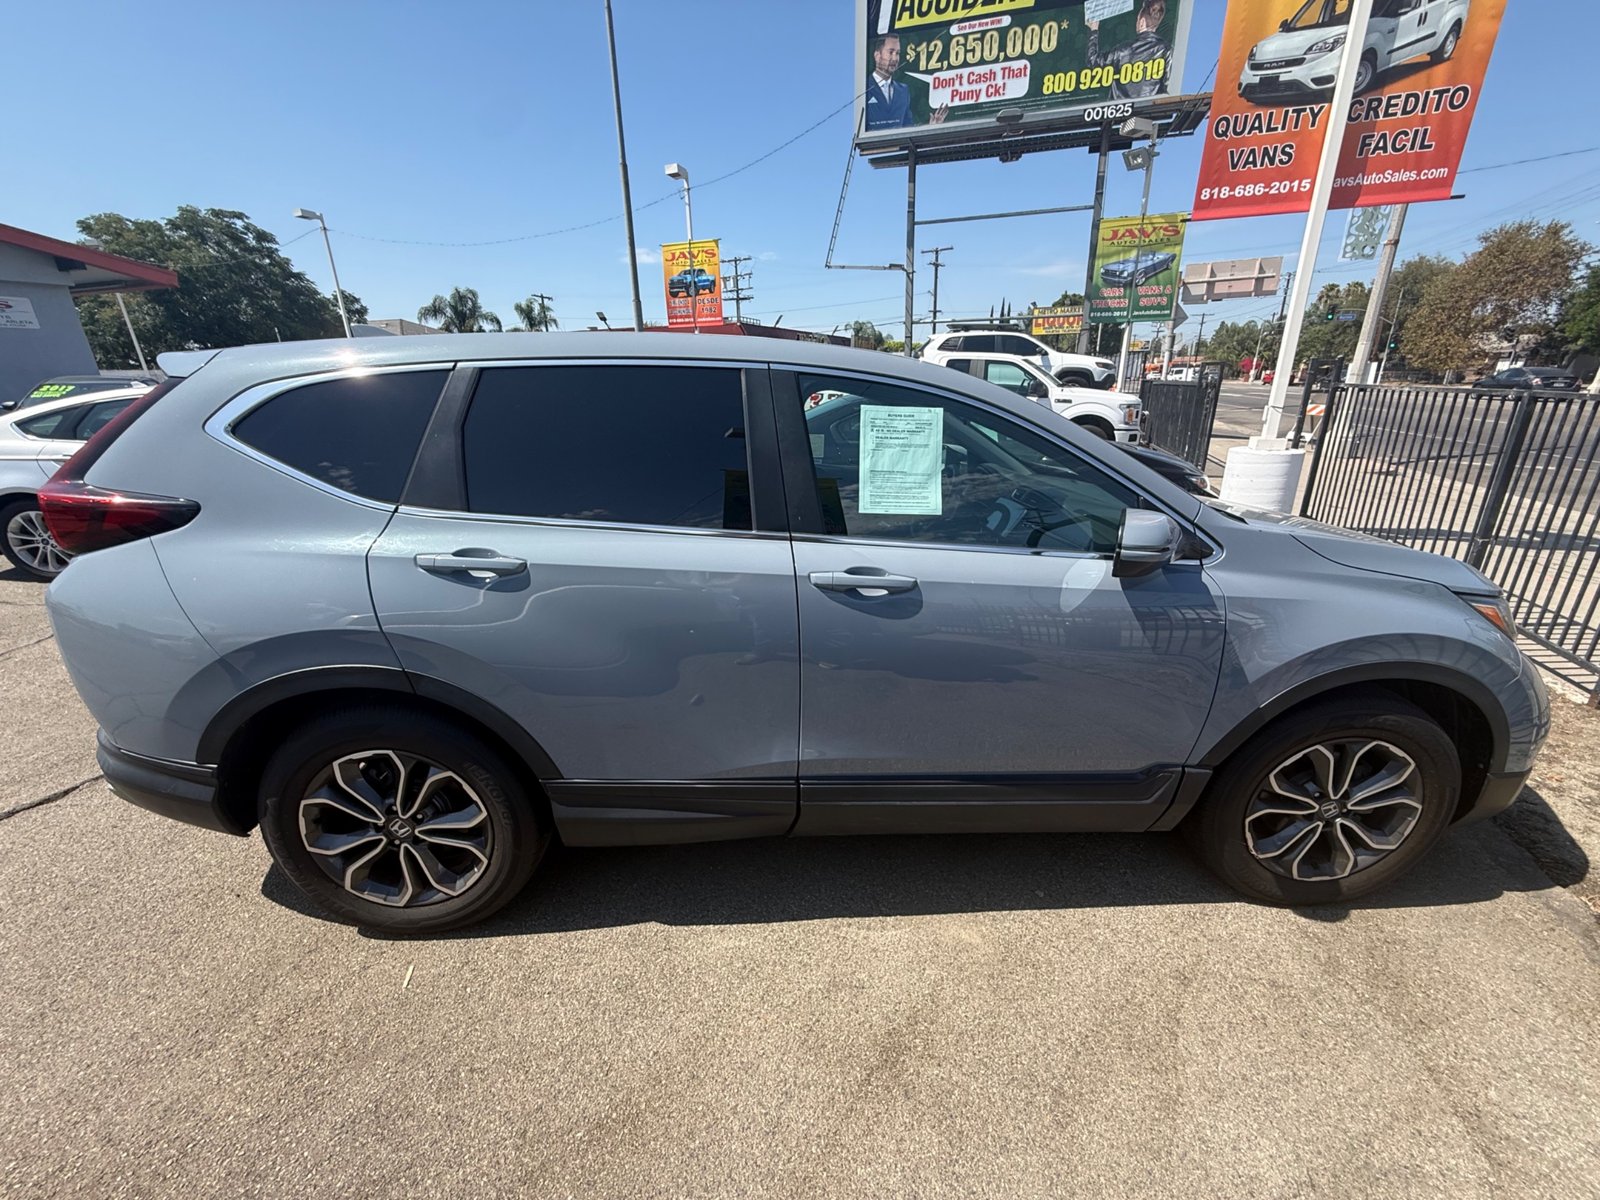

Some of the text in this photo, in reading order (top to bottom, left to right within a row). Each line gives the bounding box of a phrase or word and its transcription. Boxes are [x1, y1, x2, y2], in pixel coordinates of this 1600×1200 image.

[957, 24, 968, 32] See
[1263, 61, 1286, 69] RAM
[932, 64, 1028, 90] Don't Cash That
[1042, 58, 1165, 95] 800 920-0810
[950, 87, 982, 104] Puny
[985, 82, 1006, 98] Ck!
[1084, 103, 1133, 121] 001625
[1347, 84, 1471, 123] CREDITO
[1213, 103, 1327, 140] QUALITY
[1356, 126, 1435, 159] FACIL
[1228, 142, 1296, 172] VANS
[1333, 167, 1448, 188] avsAutoSales.com
[1200, 179, 1311, 200] 818-686-2015
[1102, 225, 1180, 241] JAV'S
[665, 249, 717, 262] JAV'S
[1099, 287, 1124, 297] CARS
[1137, 285, 1172, 295] VANS &
[1092, 298, 1128, 308] TRUCKS
[1139, 297, 1168, 306] SUV'S
[39, 384, 76, 392] 2017
